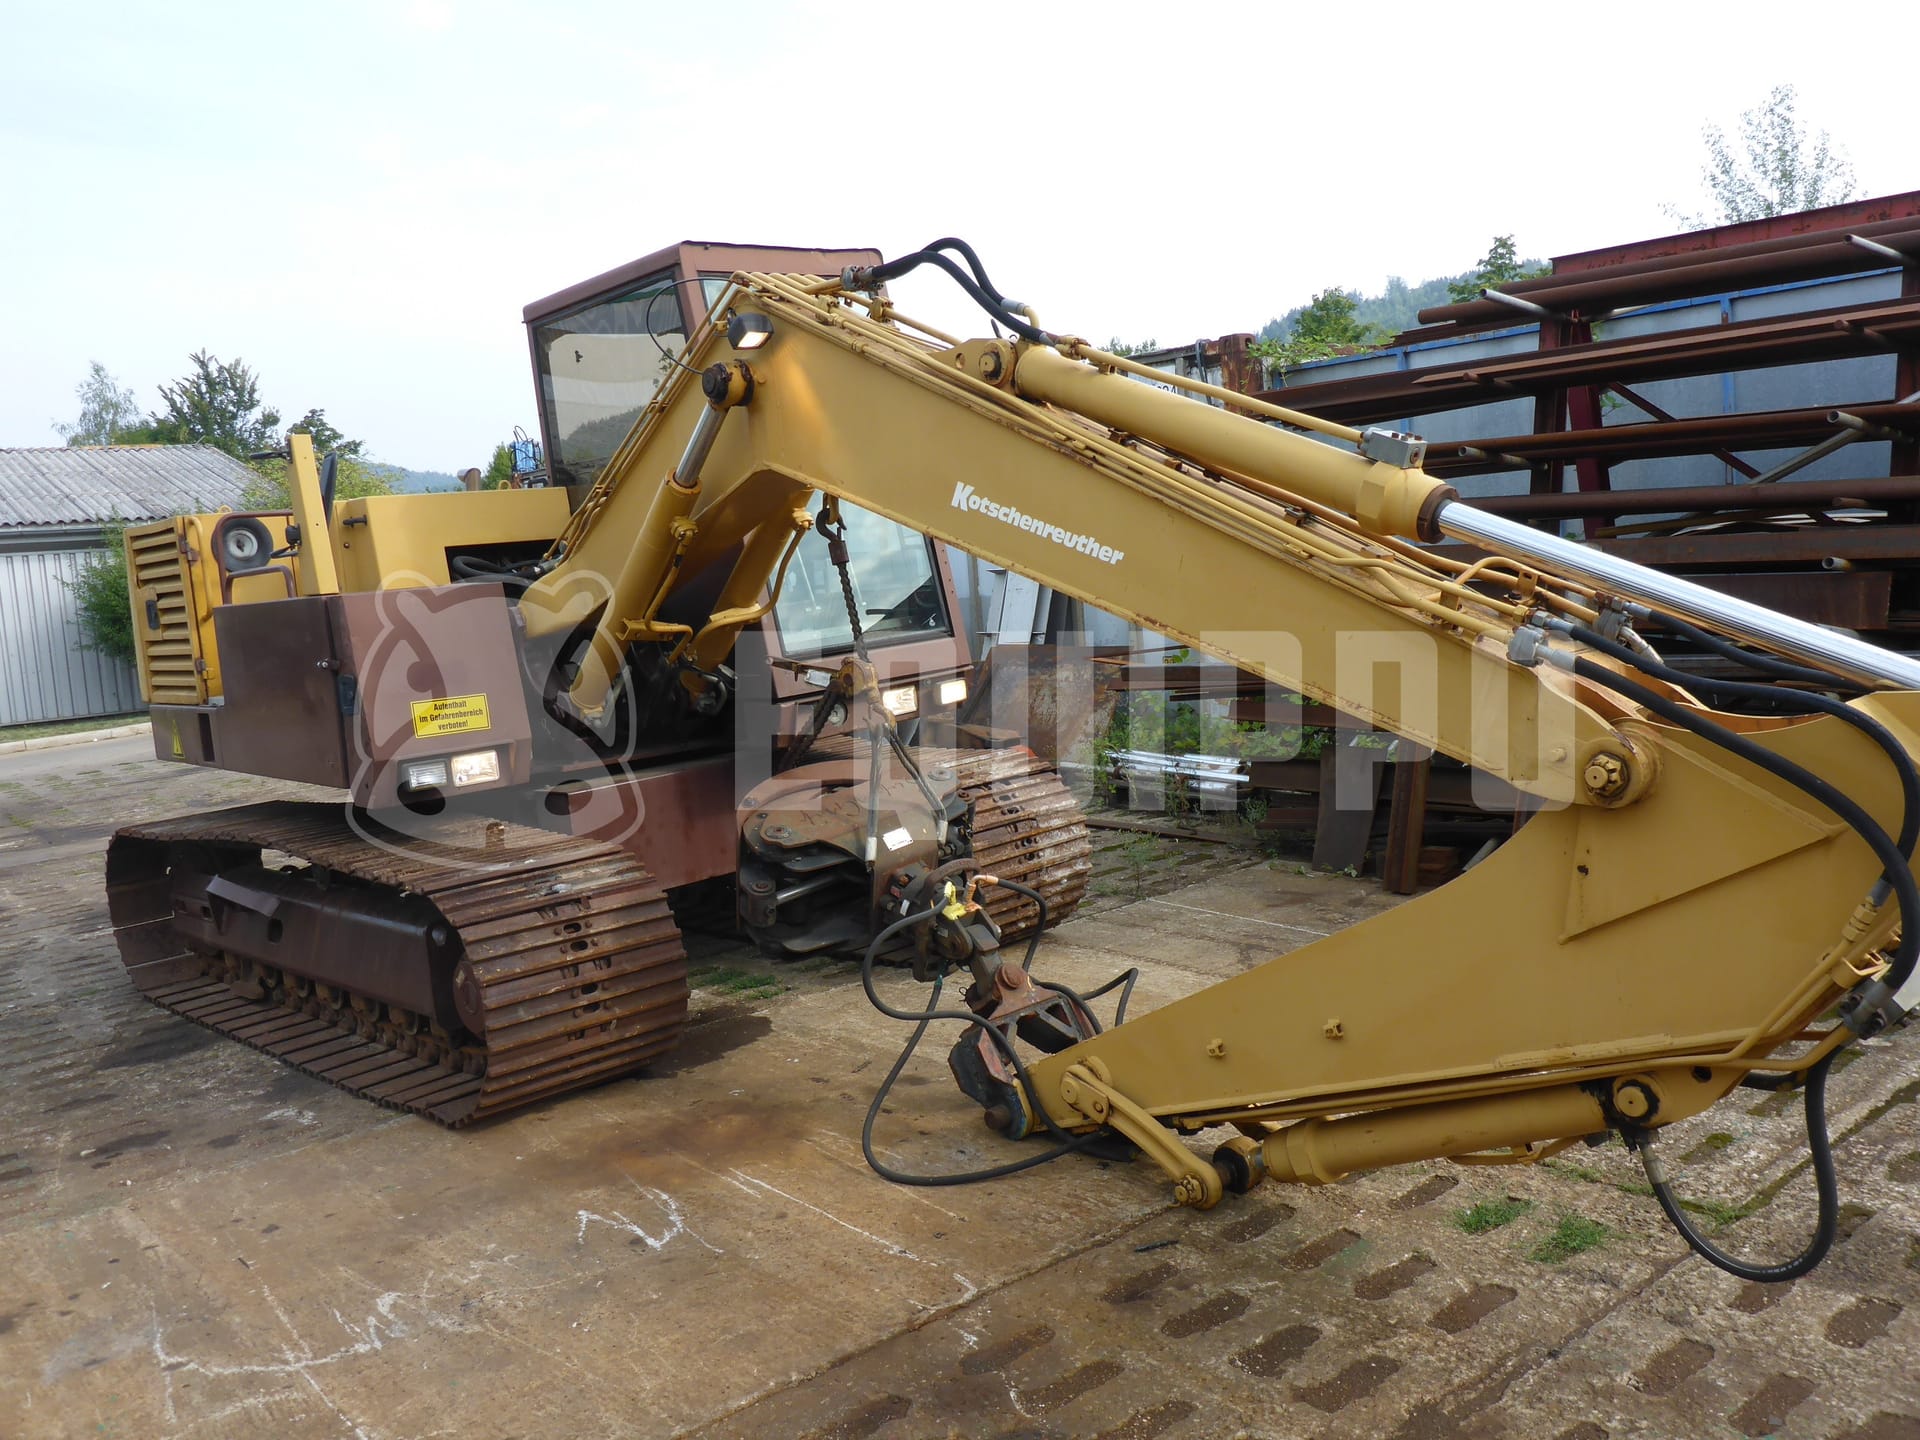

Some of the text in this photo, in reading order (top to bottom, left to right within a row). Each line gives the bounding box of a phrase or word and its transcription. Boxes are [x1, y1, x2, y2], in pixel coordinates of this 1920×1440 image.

[951, 481, 1125, 565] Kotschenreuther
[434, 700, 467, 711] Aufenthalt
[430, 708, 484, 721] Gefahrenbereich
[438, 720, 468, 731] verboten!
